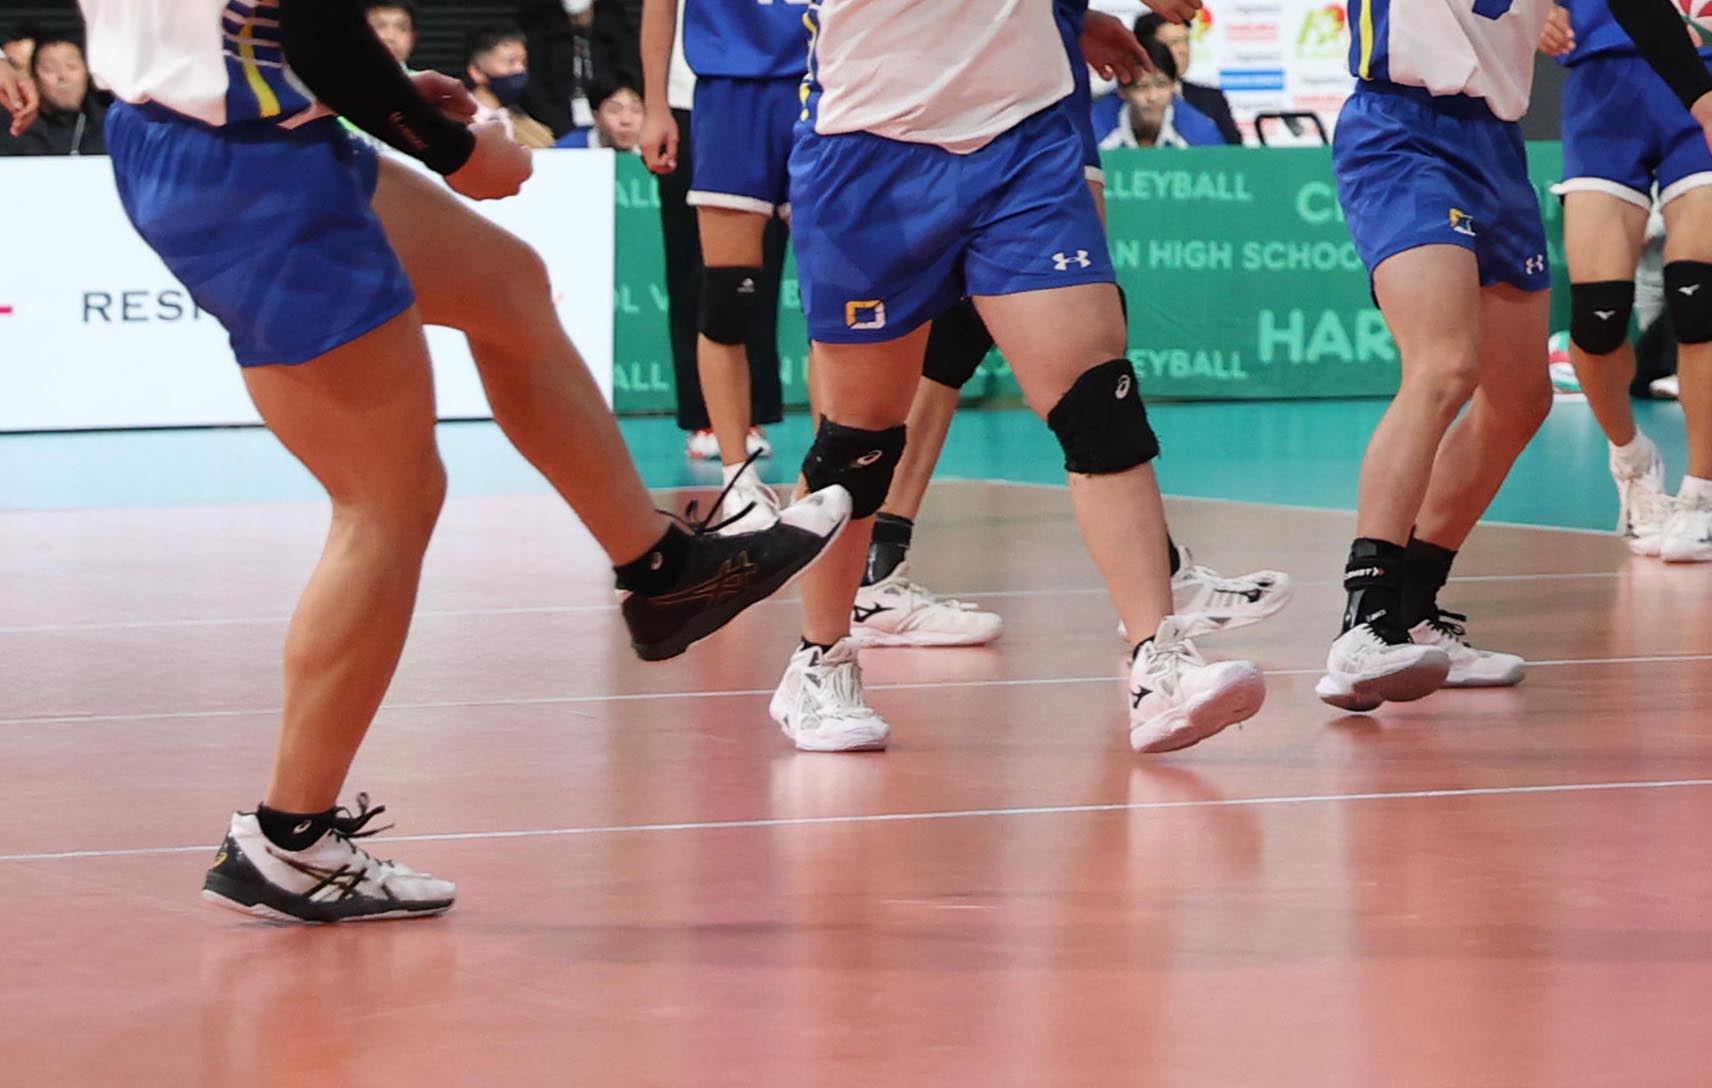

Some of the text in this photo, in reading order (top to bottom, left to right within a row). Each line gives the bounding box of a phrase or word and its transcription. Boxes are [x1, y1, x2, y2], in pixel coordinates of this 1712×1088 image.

[1103, 170, 1254, 202] LEYBALL
[1149, 239, 1234, 269] HIGH
[1256, 307, 1398, 363] HAR
